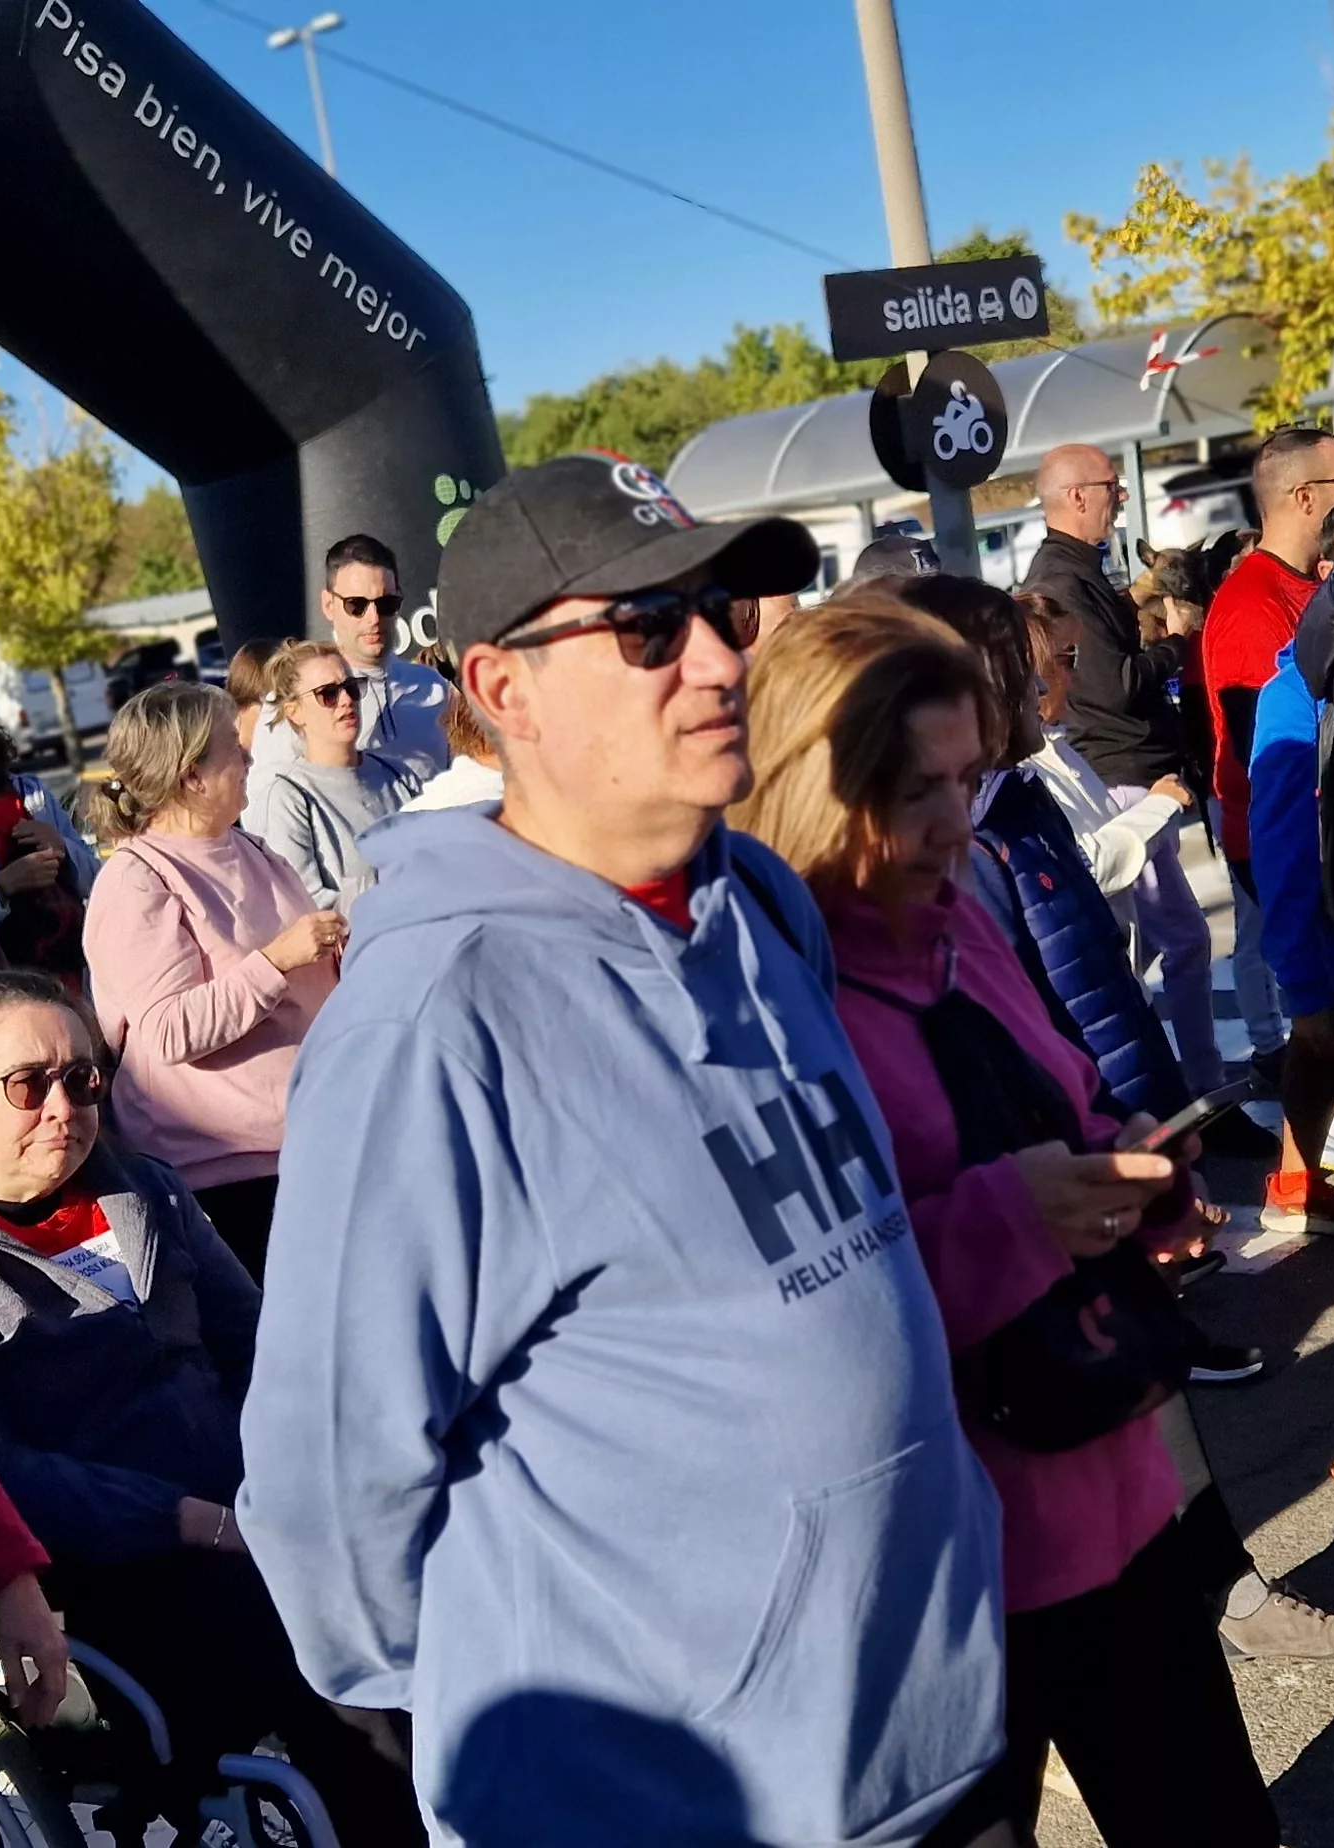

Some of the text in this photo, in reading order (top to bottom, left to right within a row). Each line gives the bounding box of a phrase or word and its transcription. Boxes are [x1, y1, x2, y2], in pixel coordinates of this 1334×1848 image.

[34, 0, 427, 351] Pisa bien, vive mejor
[882, 284, 972, 332] salida
[702, 1070, 895, 1266] HH
[777, 1245, 850, 1305] HELLY
